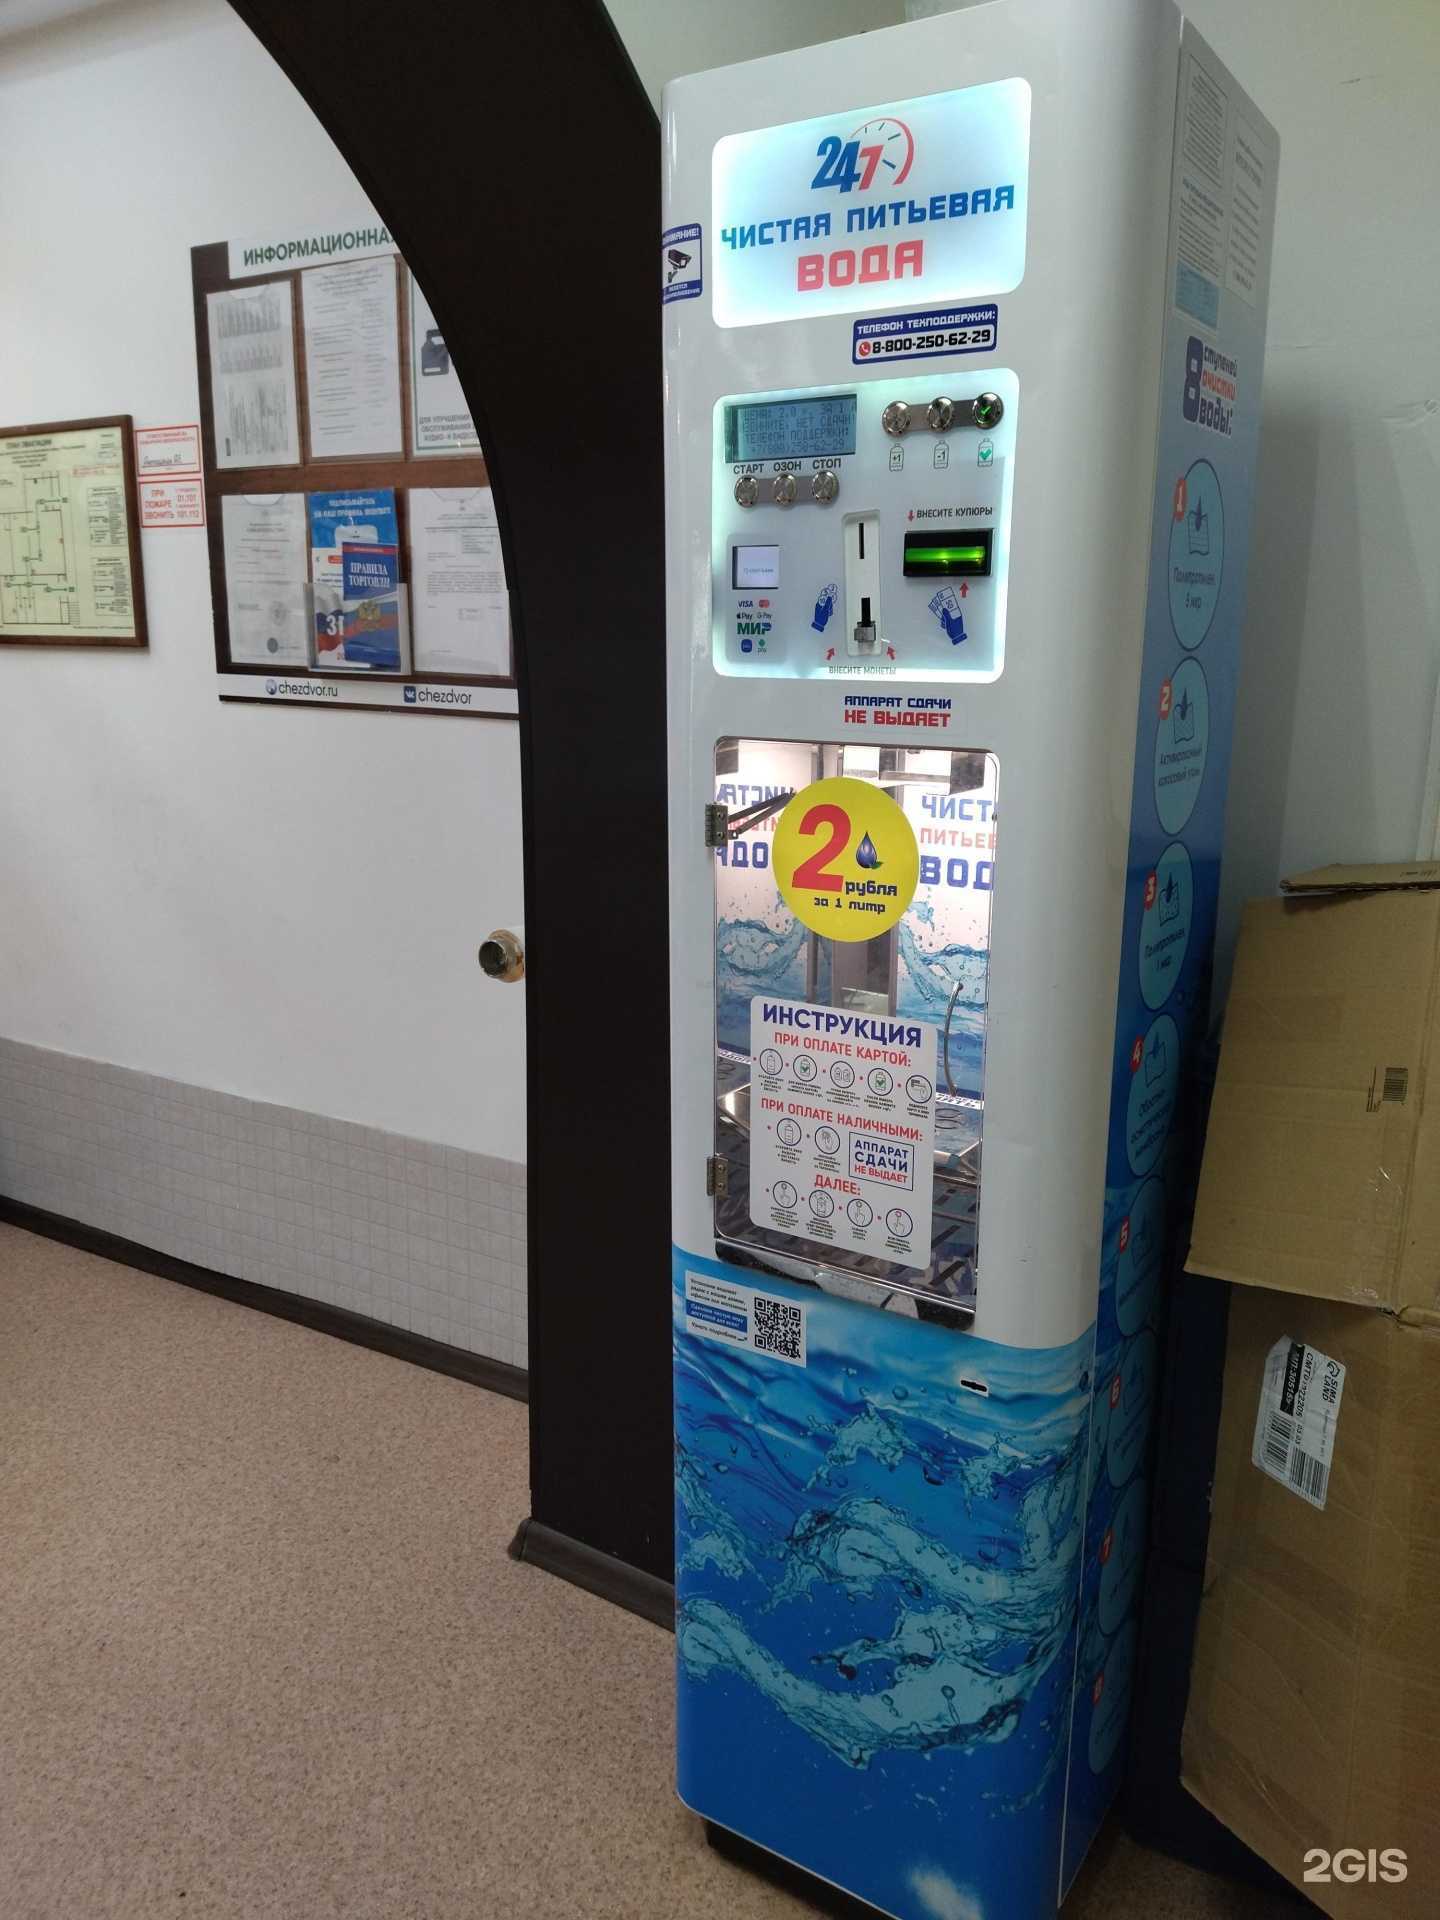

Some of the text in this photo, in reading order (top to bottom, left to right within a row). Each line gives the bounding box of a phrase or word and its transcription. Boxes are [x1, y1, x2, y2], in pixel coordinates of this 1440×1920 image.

[721, 184, 1015, 250] ЧИСТАЯ ПИТЬЕВАЯ
[243, 226, 395, 266] ИНФОРМАЦИОННА
[797, 240, 924, 292] ВОДА
[857, 310, 996, 335] ТЕЛЕФОН ТЕХПОДДЕРЖКИ:
[873, 329, 991, 354] 8-800-250-62-29
[733, 463, 764, 475] СТАРТ
[773, 461, 802, 472] ОЗОН
[812, 458, 842, 470] СТОП
[917, 506, 993, 519] ВНЕСИТЕ КУПЮРЫ
[350, 562, 388, 575] ПРАВИЛА
[349, 575, 390, 588] ТОРГОВЛИ
[738, 600, 754, 608] VISA
[737, 622, 772, 635] МИР
[829, 665, 897, 676] ВНЕСИТЕ МОНЕТЫ
[278, 681, 338, 697] chezdvor.ru
[418, 688, 472, 704] chezdvor
[844, 695, 951, 709] АППАРАТ СДАЧИ
[844, 709, 951, 728] НЕ ВЫДАЕТ
[792, 803, 852, 893] 2
[845, 880, 897, 897] рубля
[814, 897, 886, 914] за 1 литр
[763, 1003, 922, 1048] ИНСТРУКЦИЯ
[774, 1032, 911, 1067] ПРИ ОПЛАТЕ КАРТОЙ:
[761, 1097, 923, 1142] ПРИ ОПЛАТЕ НАЛИЧНЫМИ:
[855, 1139, 909, 1159] АППАРАТ
[855, 1150, 908, 1173] СДАЧИ
[855, 1164, 868, 1175] НЕ
[868, 1167, 908, 1184] ВЫДАЕТ
[814, 1174, 862, 1196] ДАЛЕЕ:
[1322, 1374, 1331, 1401] LAND
[1329, 1379, 1338, 1404] SIMA
